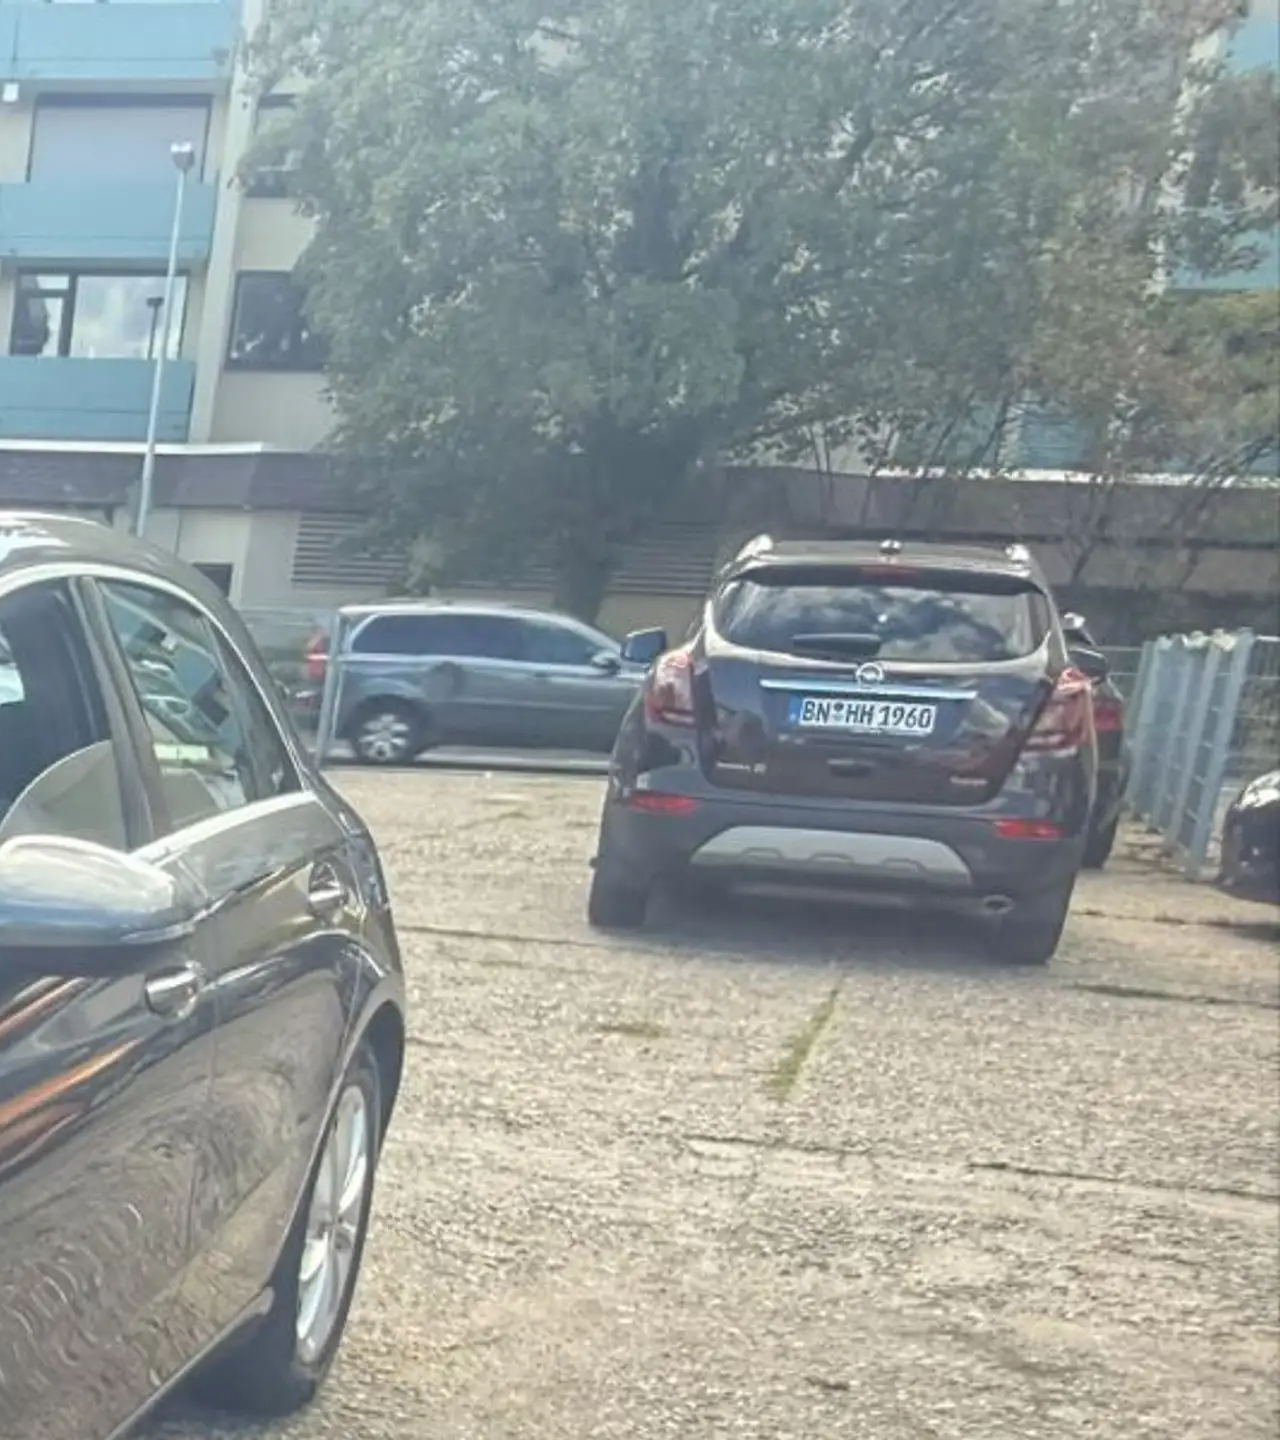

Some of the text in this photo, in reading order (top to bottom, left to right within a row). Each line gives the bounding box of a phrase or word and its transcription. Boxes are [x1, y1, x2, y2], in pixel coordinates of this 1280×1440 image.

[802, 700, 932, 729] BN HH 1960
